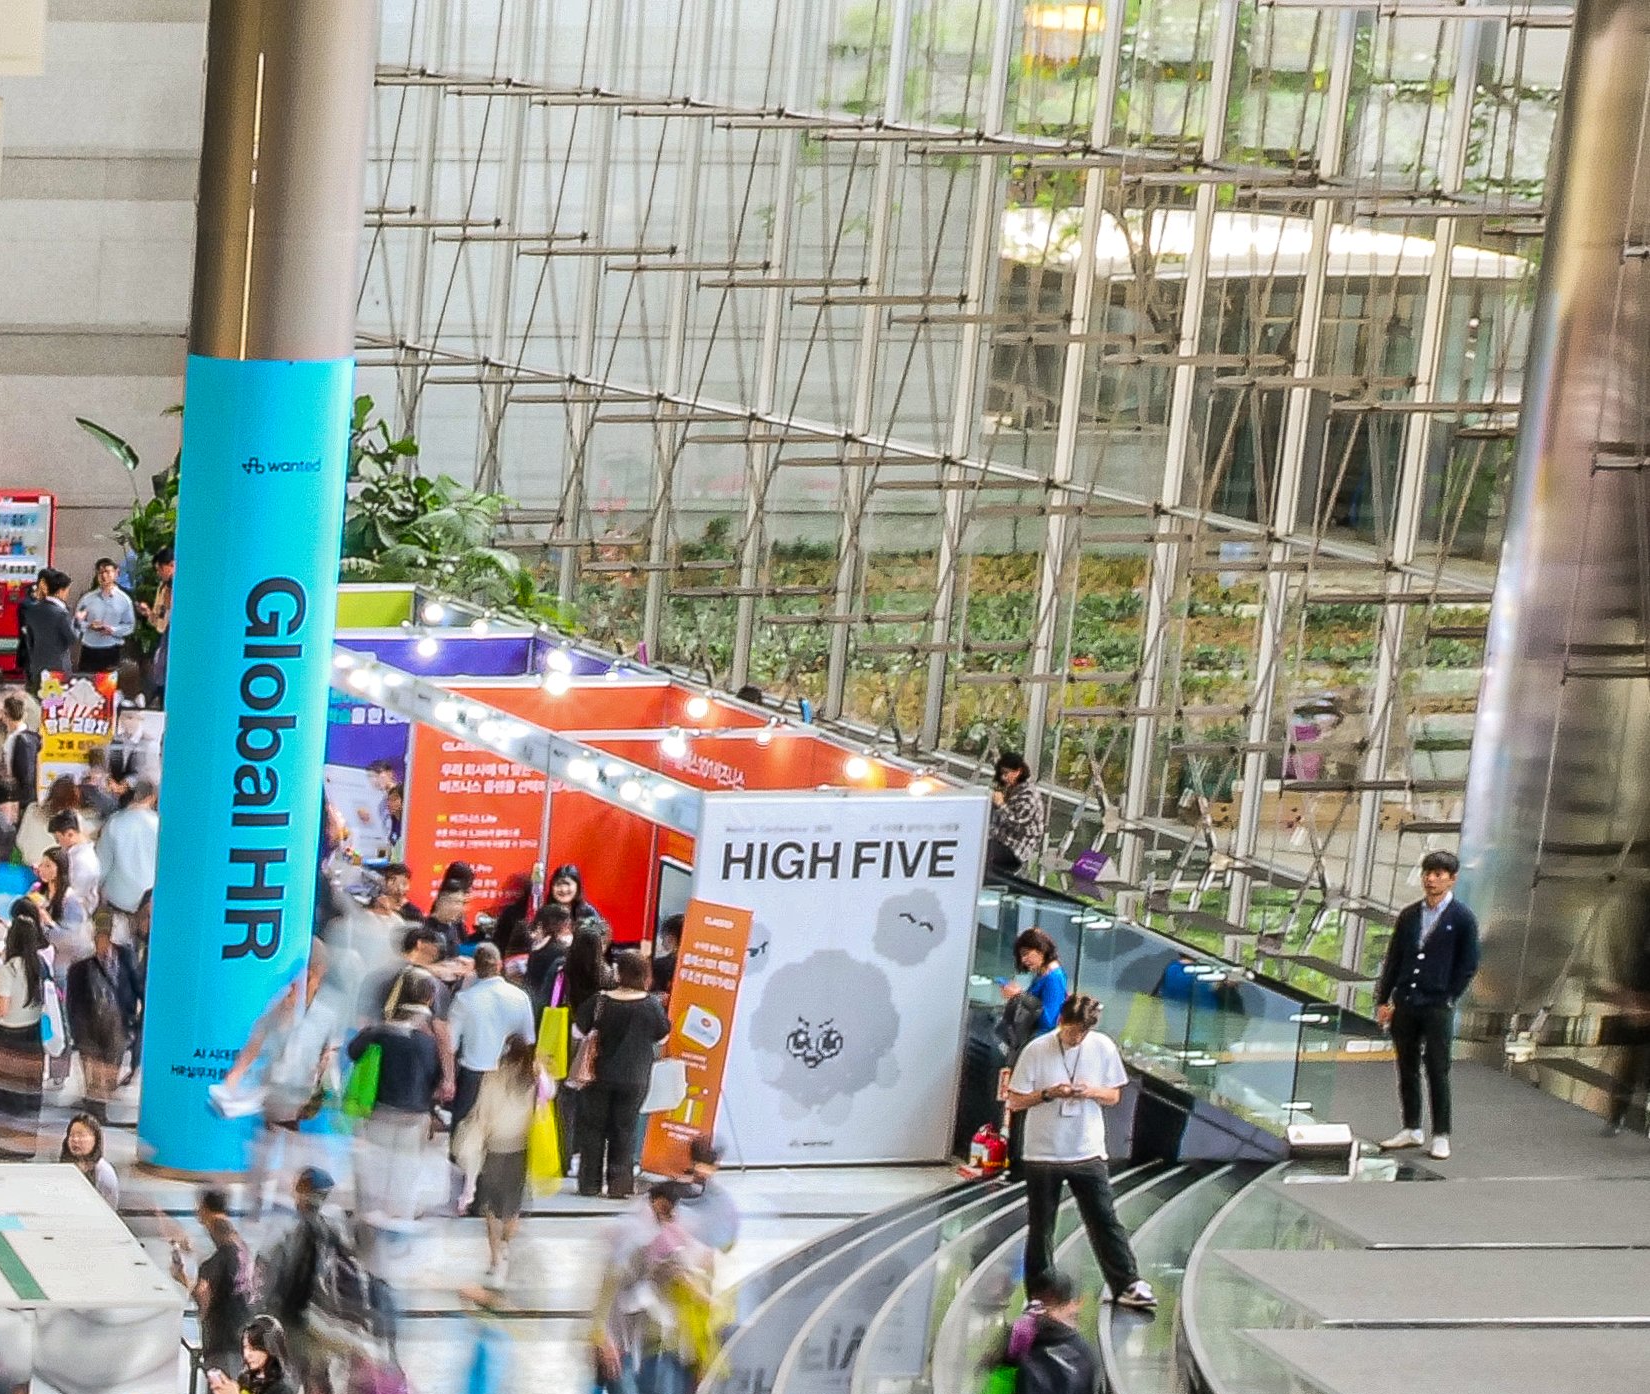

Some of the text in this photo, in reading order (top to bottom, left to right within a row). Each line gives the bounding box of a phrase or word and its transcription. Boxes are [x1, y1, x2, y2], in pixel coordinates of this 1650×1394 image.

[222, 576, 307, 962] Global HR
[721, 840, 958, 880] HIGH FIVE
